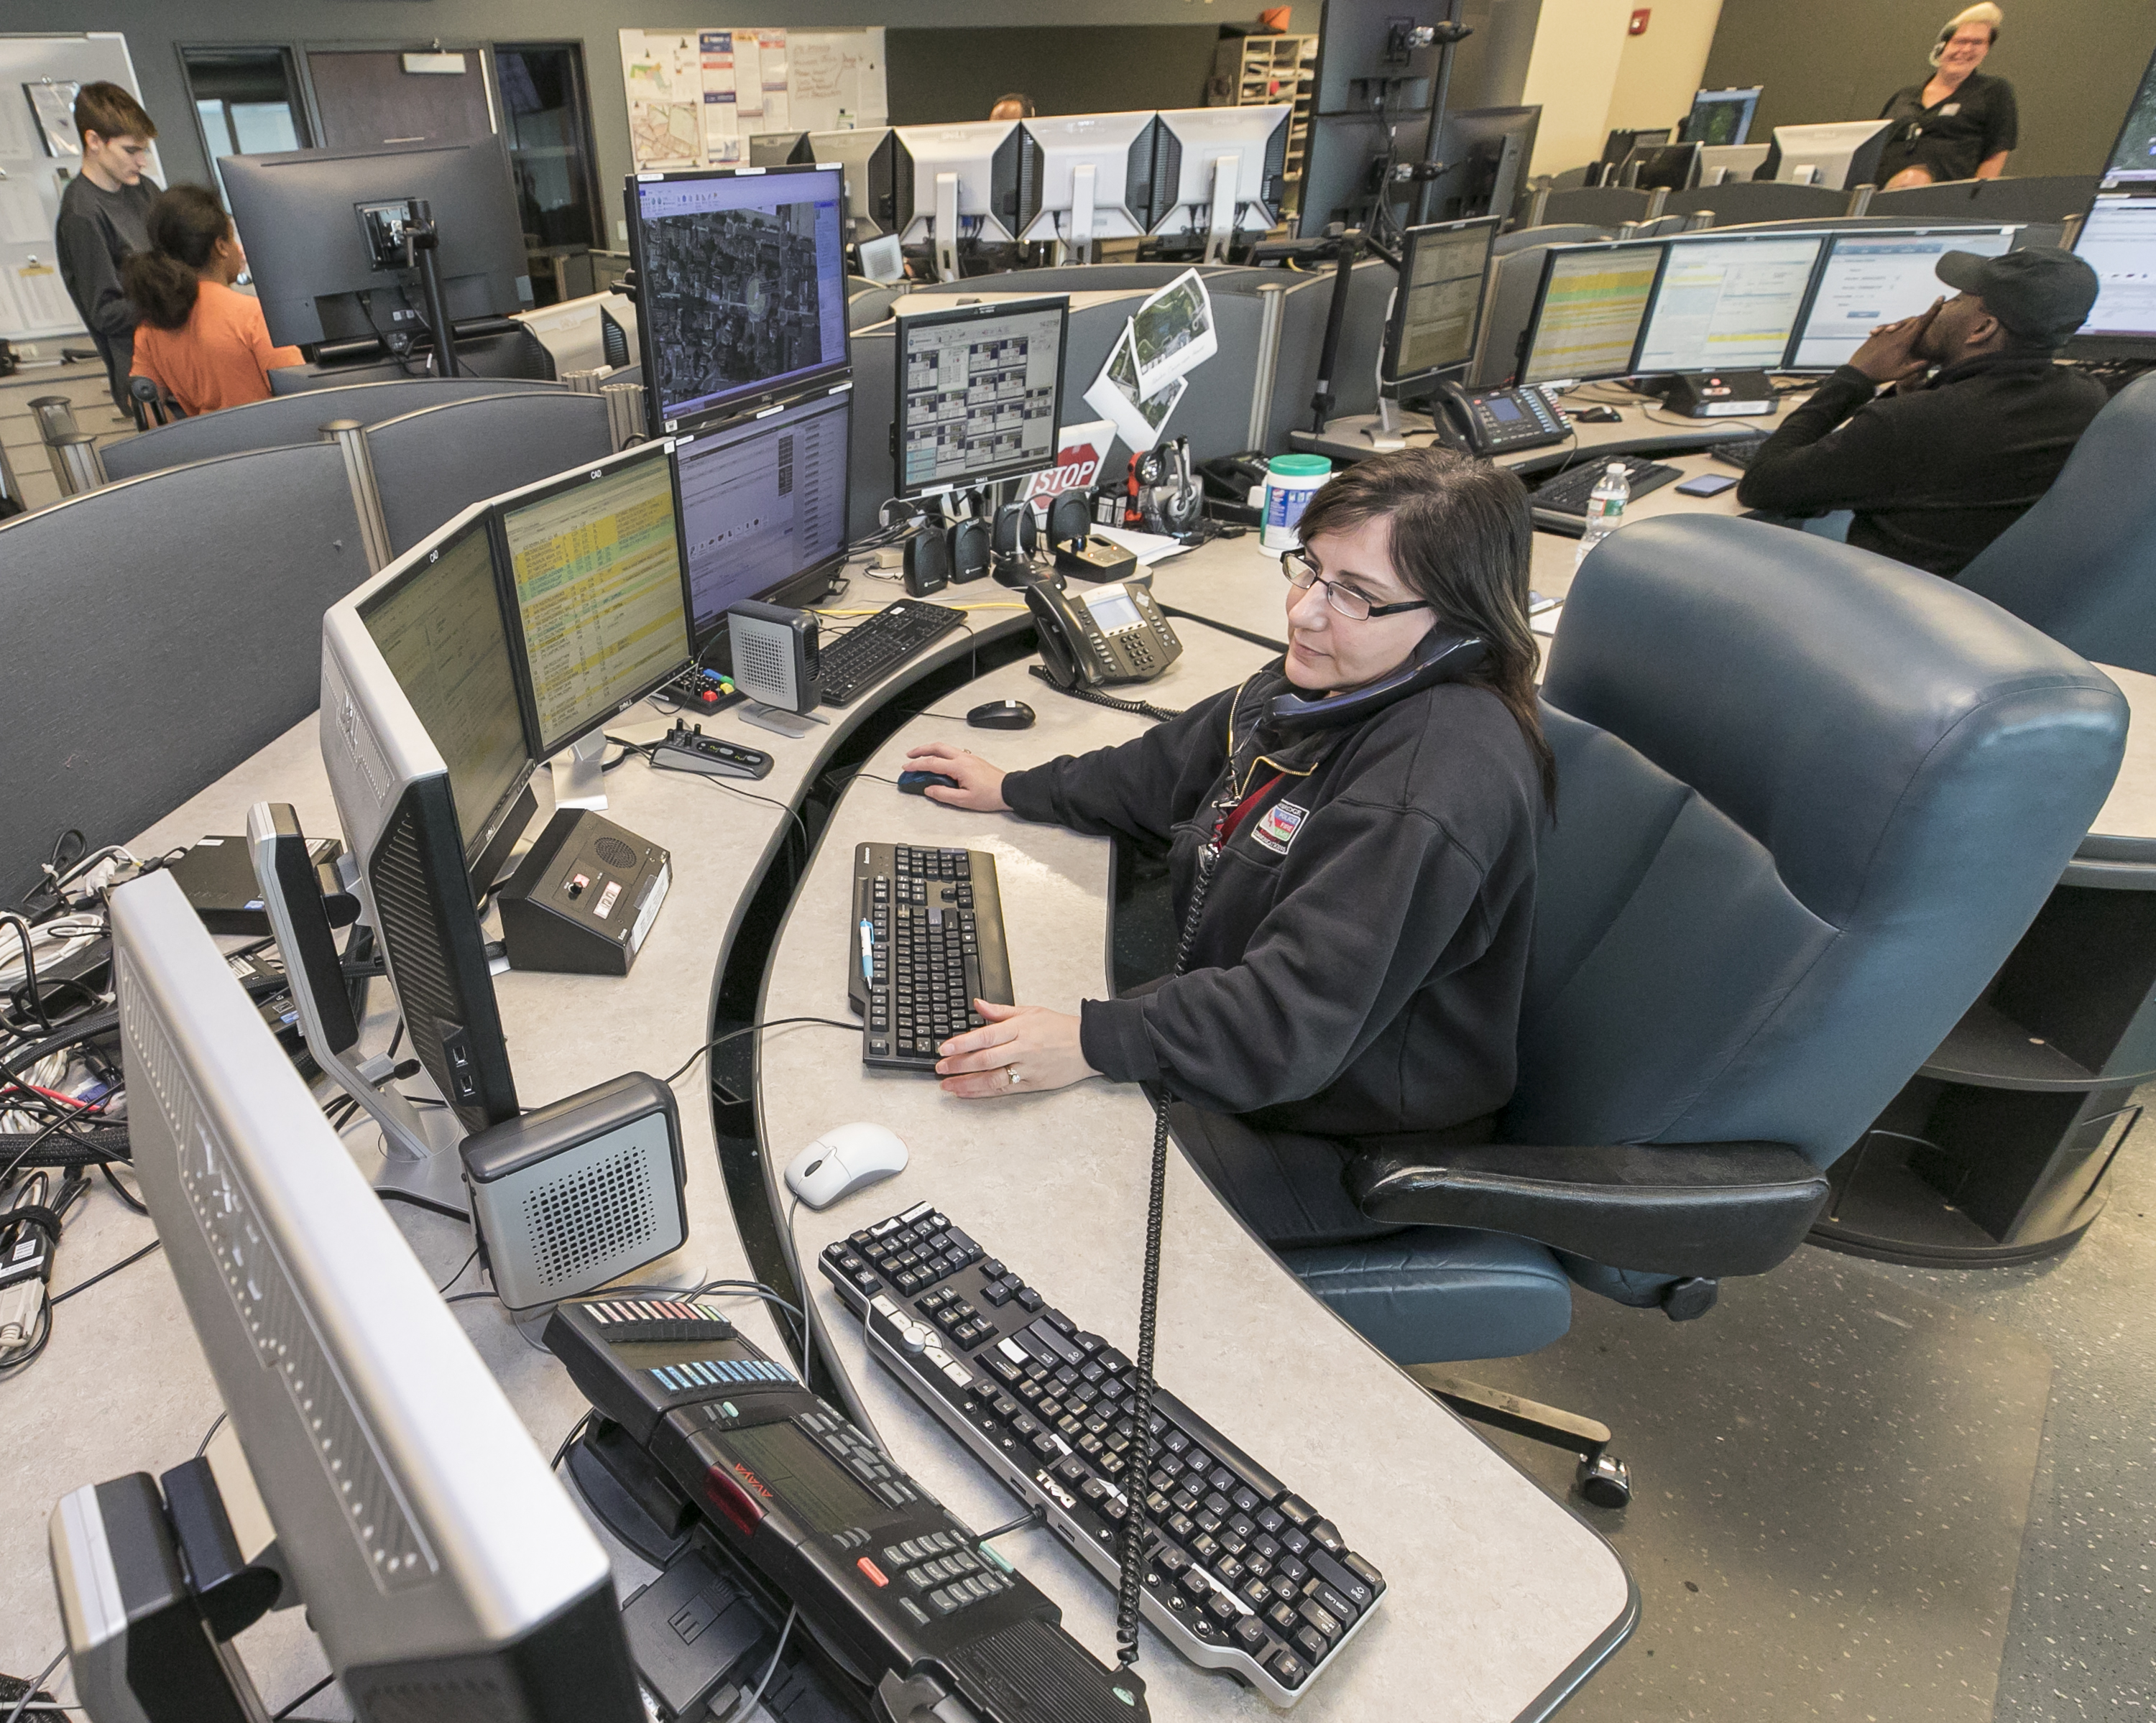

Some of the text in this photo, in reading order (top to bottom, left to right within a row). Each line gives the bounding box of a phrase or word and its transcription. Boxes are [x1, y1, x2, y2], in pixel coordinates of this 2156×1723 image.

[1035, 461, 1095, 493] STOP
[619, 699, 632, 711] DELL
[1279, 812, 1298, 824] POLICE
[1280, 822, 1294, 831] FIRE
[1277, 828, 1289, 839] EMS
[734, 1463, 773, 1498] AVAYA
[1036, 1469, 1077, 1509] DELL
[1266, 1521, 1276, 1530] X
[1253, 1563, 1263, 1574] W
[1281, 1589, 1291, 1597] Q
